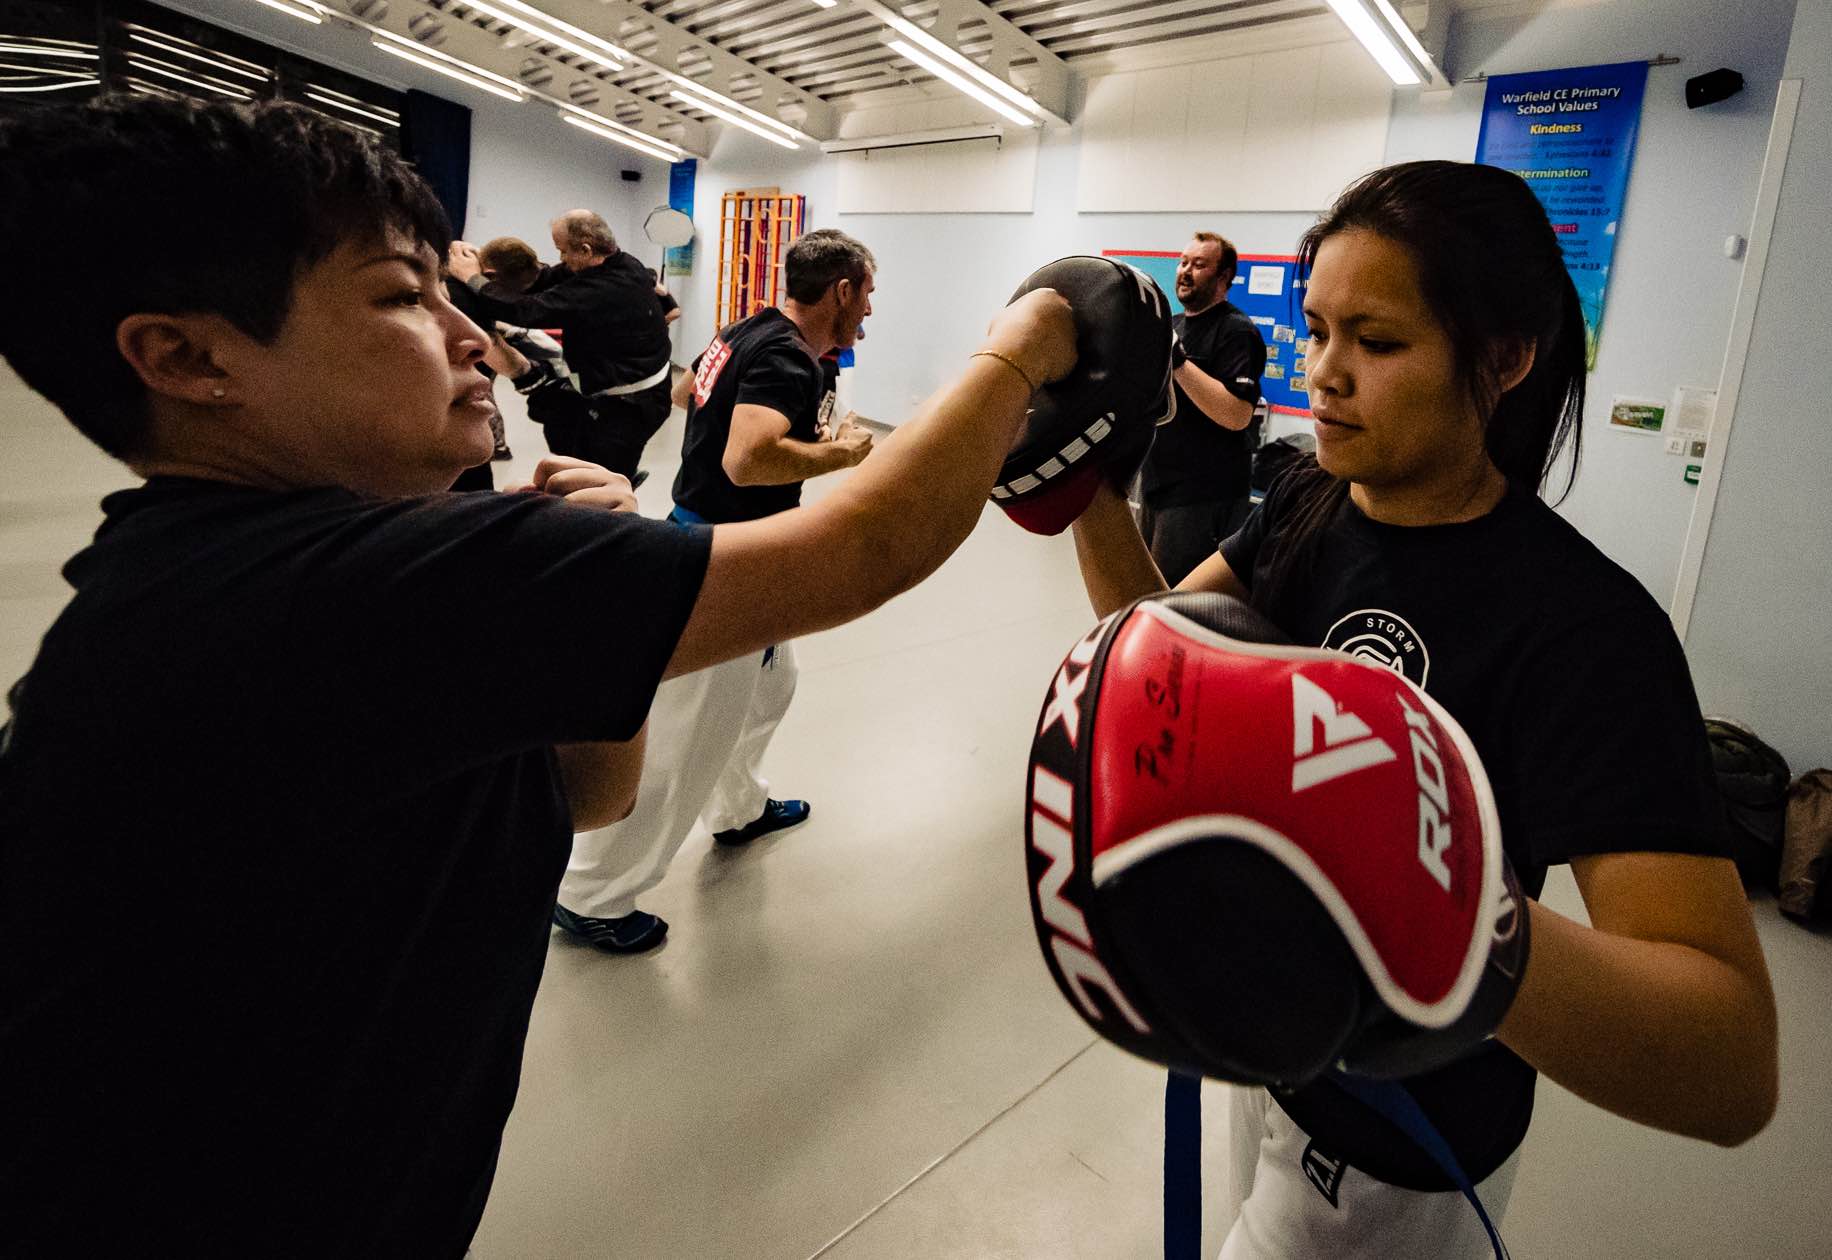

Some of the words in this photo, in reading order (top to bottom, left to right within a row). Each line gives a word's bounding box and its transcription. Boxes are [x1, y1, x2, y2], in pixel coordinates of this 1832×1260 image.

[1502, 90, 1551, 104] Warfield
[1553, 89, 1568, 100] CE
[1571, 87, 1620, 98] Primary
[1516, 102, 1556, 115] School
[1559, 101, 1598, 112] Values
[1530, 123, 1582, 135] Kindness
[1508, 168, 1589, 178] termination
[1366, 617, 1415, 653] STORM
[1396, 691, 1452, 893] RDX
